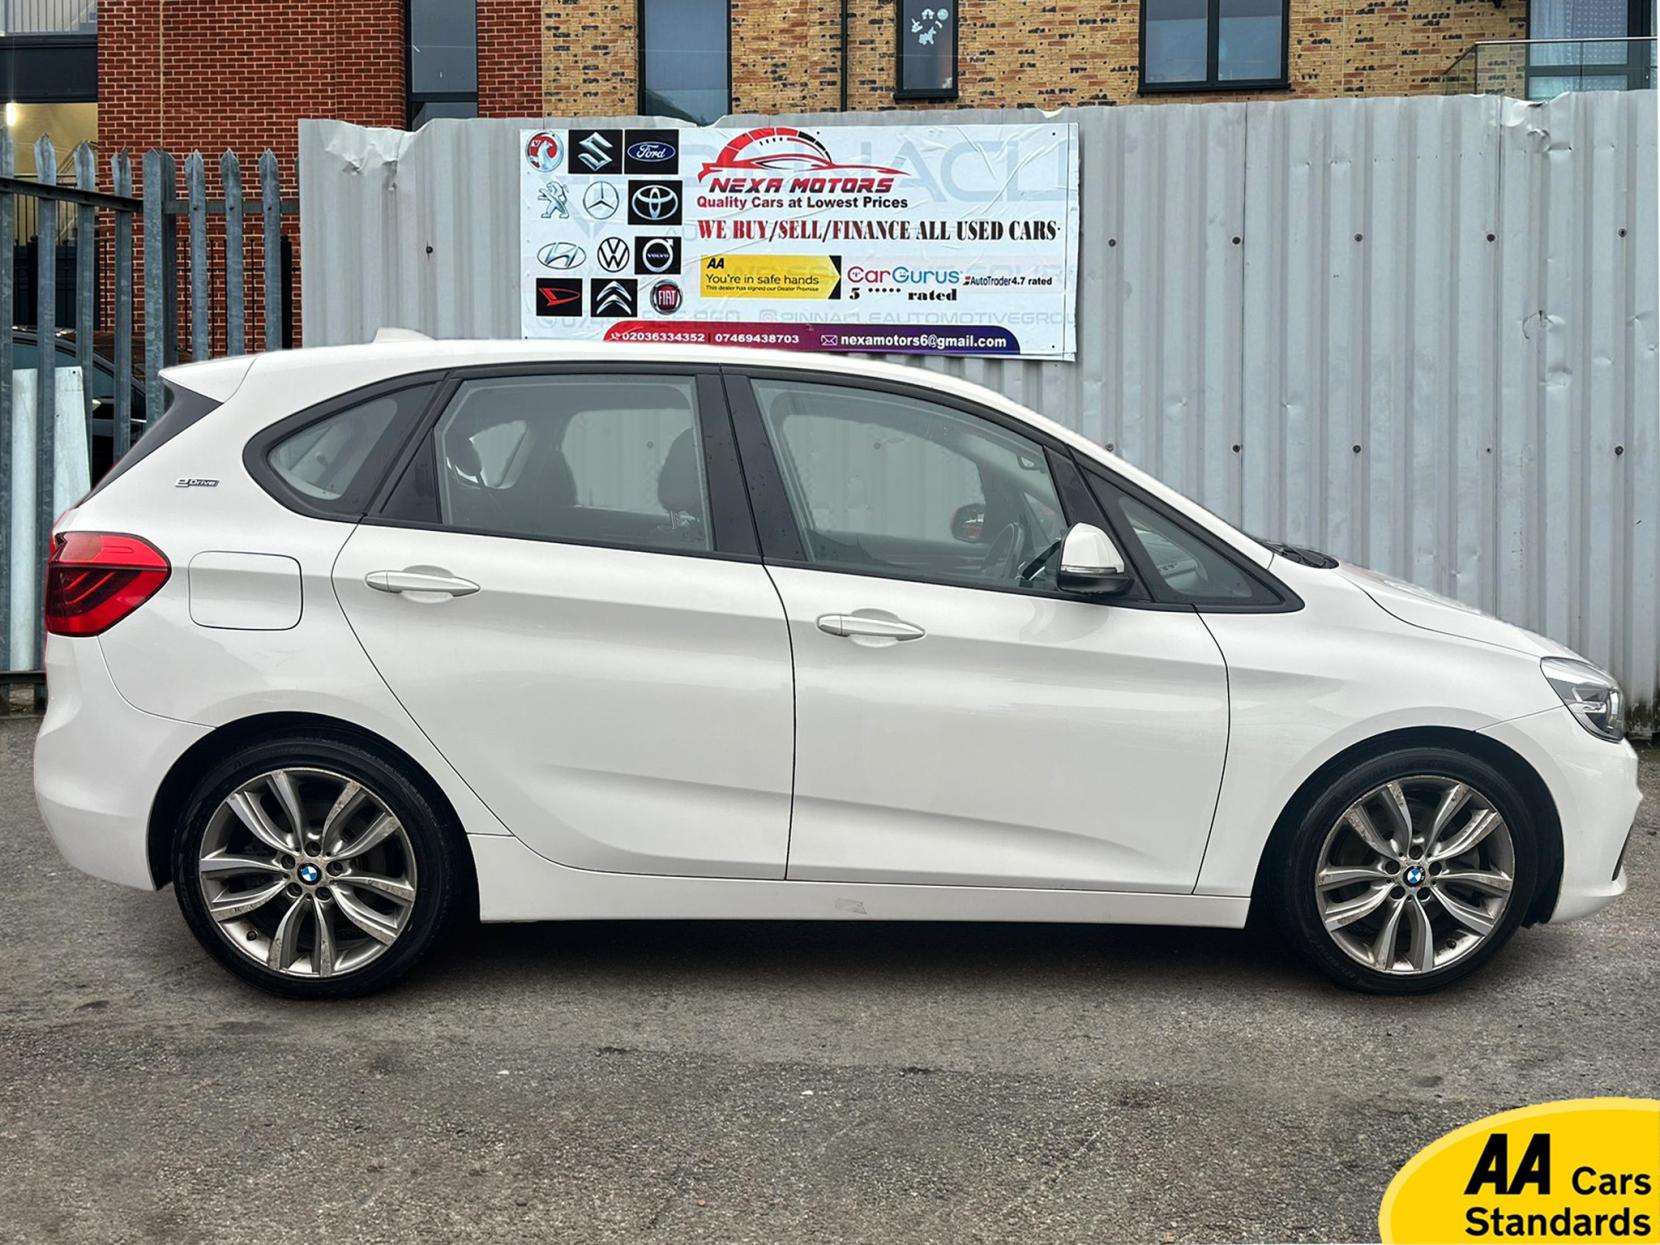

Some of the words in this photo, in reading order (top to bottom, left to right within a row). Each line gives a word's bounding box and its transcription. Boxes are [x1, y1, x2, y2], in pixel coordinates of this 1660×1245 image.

[636, 144, 666, 159] Ford
[709, 177, 784, 193] NEXA
[789, 177, 895, 193] MOTORS
[697, 196, 747, 211] Quality
[752, 196, 784, 208] Cars
[788, 196, 803, 208] at
[807, 196, 859, 208] Lowest
[863, 196, 908, 208] Prices
[697, 220, 727, 240] WE
[733, 219, 911, 243] BUY/SELL/FINANCE
[916, 220, 951, 240] ALL
[956, 220, 1004, 240] USED
[1009, 220, 1057, 240] CARS
[706, 258, 725, 269] AA
[705, 274, 741, 284] You're
[744, 274, 755, 284] in
[757, 274, 781, 284] safe
[784, 274, 819, 285] hands
[847, 266, 960, 284] CarGurus
[1011, 277, 1026, 286] 4.7
[1028, 277, 1053, 286] rated
[658, 290, 676, 305] FIAT
[849, 288, 860, 300] 5
[908, 288, 957, 301] rated
[622, 333, 705, 343] 02036334352
[715, 334, 800, 344] 07469438703
[841, 334, 1007, 349] nexamotors6@gmail.com
